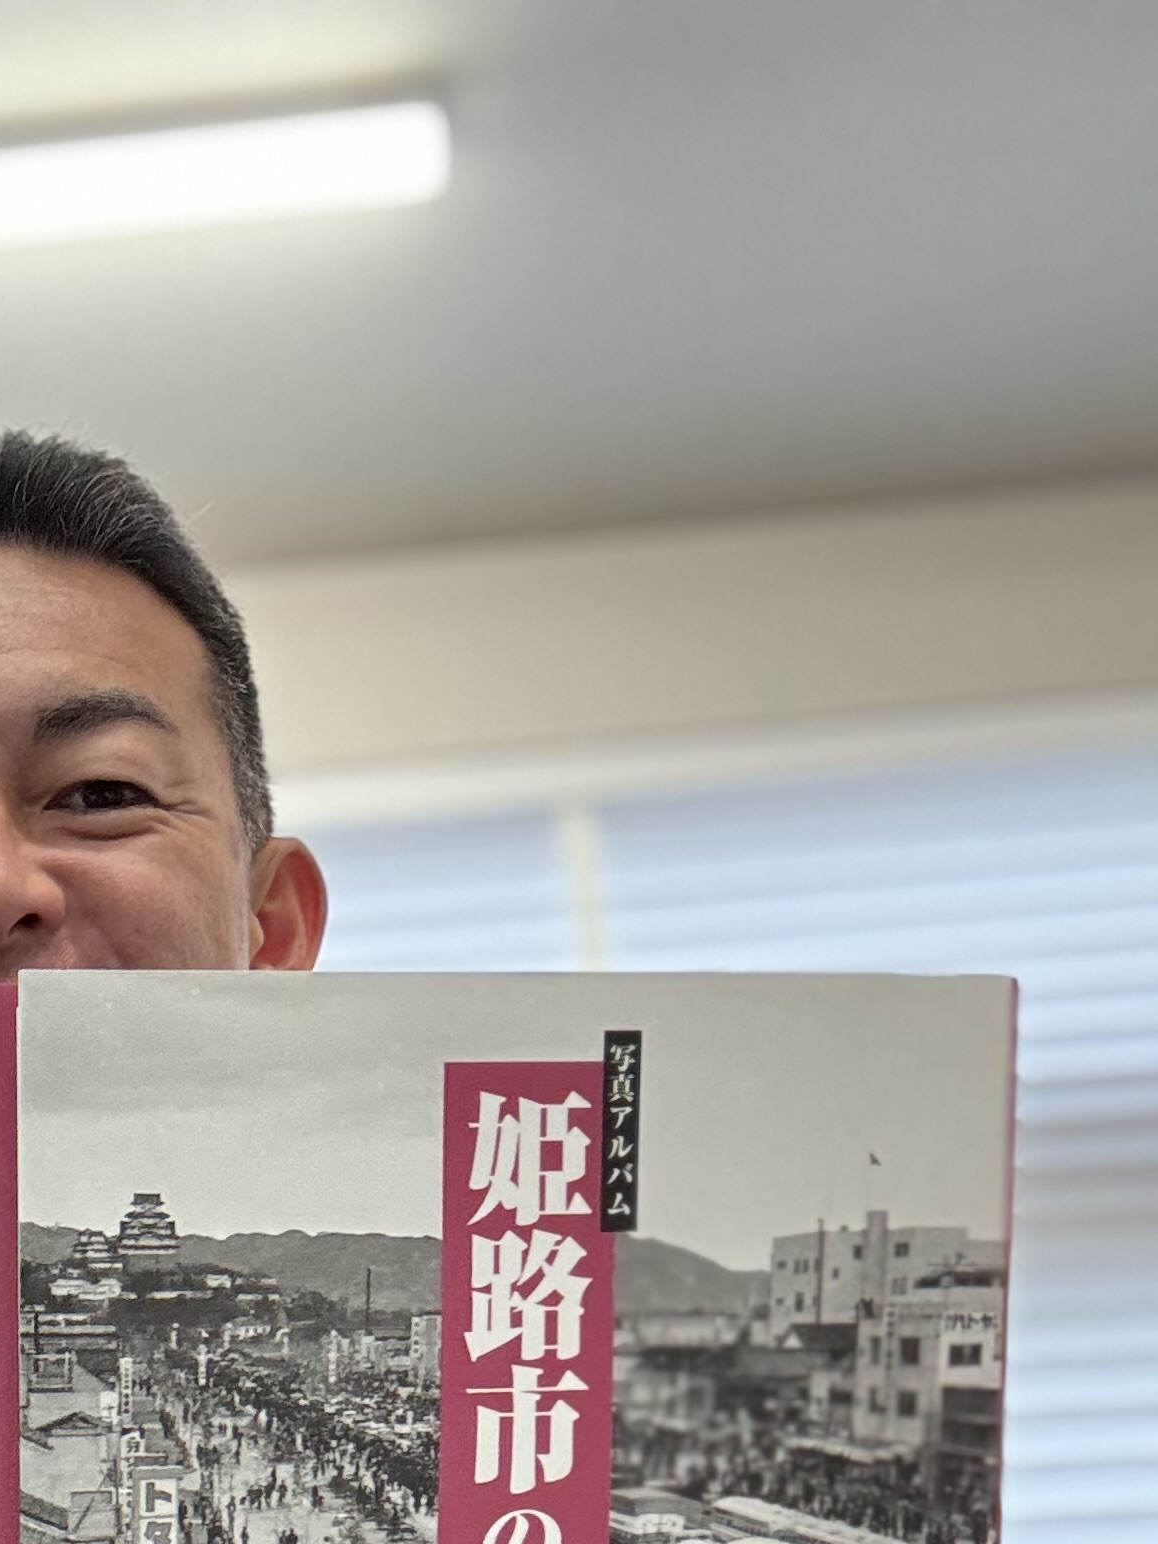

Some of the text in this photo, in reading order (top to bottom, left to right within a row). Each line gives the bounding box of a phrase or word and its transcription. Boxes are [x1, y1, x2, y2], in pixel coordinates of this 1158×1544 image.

[607, 1044, 636, 1216] 写真アルバム
